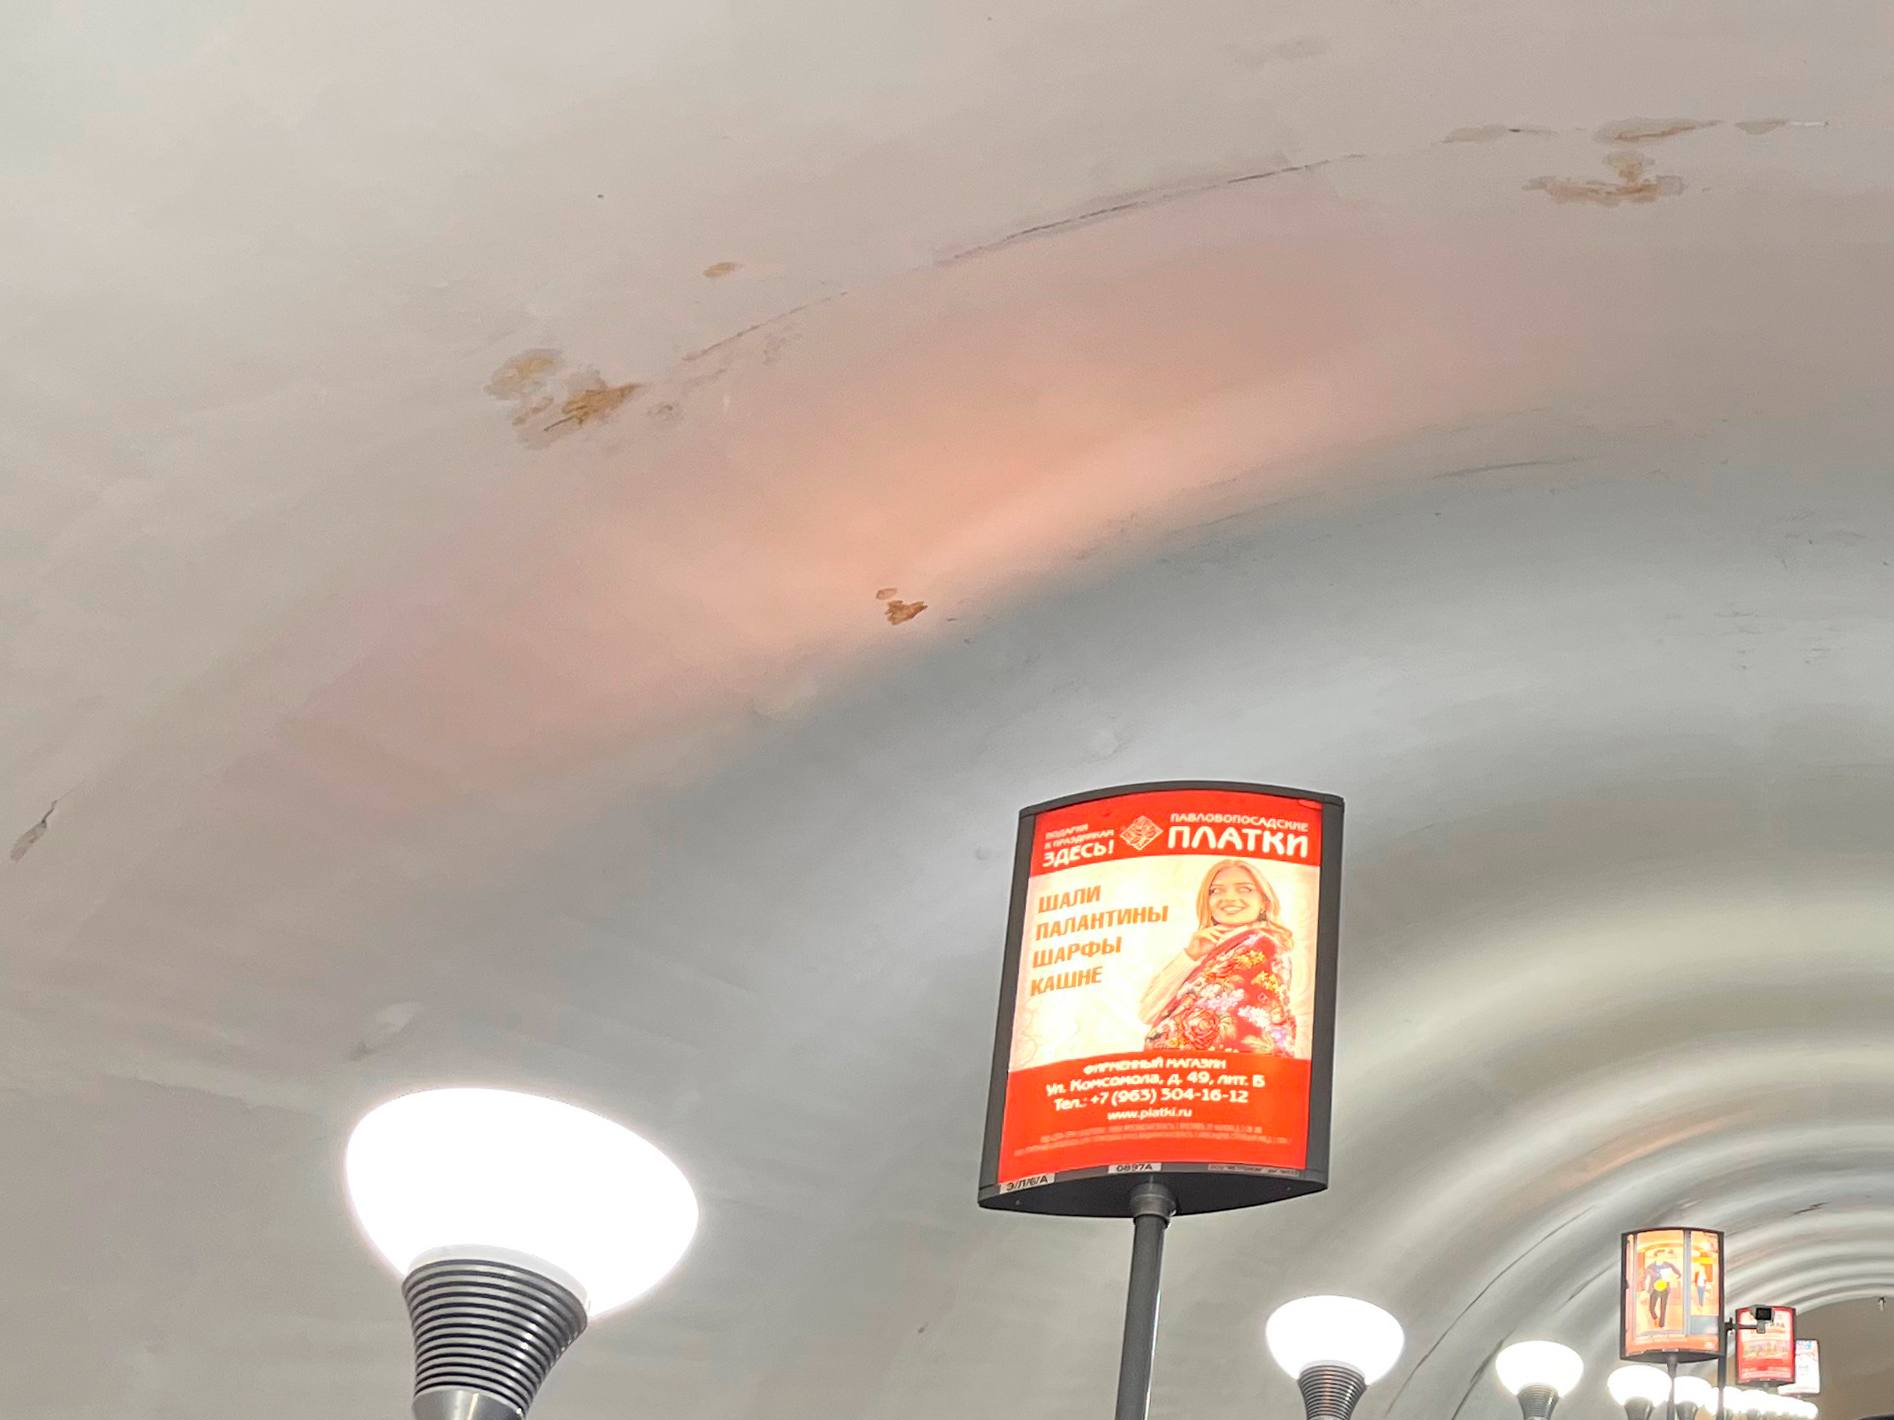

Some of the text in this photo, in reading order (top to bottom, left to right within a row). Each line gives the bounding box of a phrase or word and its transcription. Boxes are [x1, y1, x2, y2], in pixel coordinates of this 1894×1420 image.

[1170, 812, 1309, 832] ПАВЛОВОПОСАДСКИЕ
[1042, 839, 1115, 868] ЗДЕСЬ!
[1167, 825, 1309, 858] ПЛАТКИ
[1038, 885, 1101, 914] ШАЛИ
[1036, 905, 1169, 941] ПАЛАНТИНЫ
[1032, 936, 1122, 968] ШАРФЫ
[1030, 966, 1103, 997] КАШНЕ
[1166, 1058, 1226, 1070] МАГАЗИН
[1187, 1071, 1214, 1086] 49,
[1090, 1092, 1109, 1105] +7
